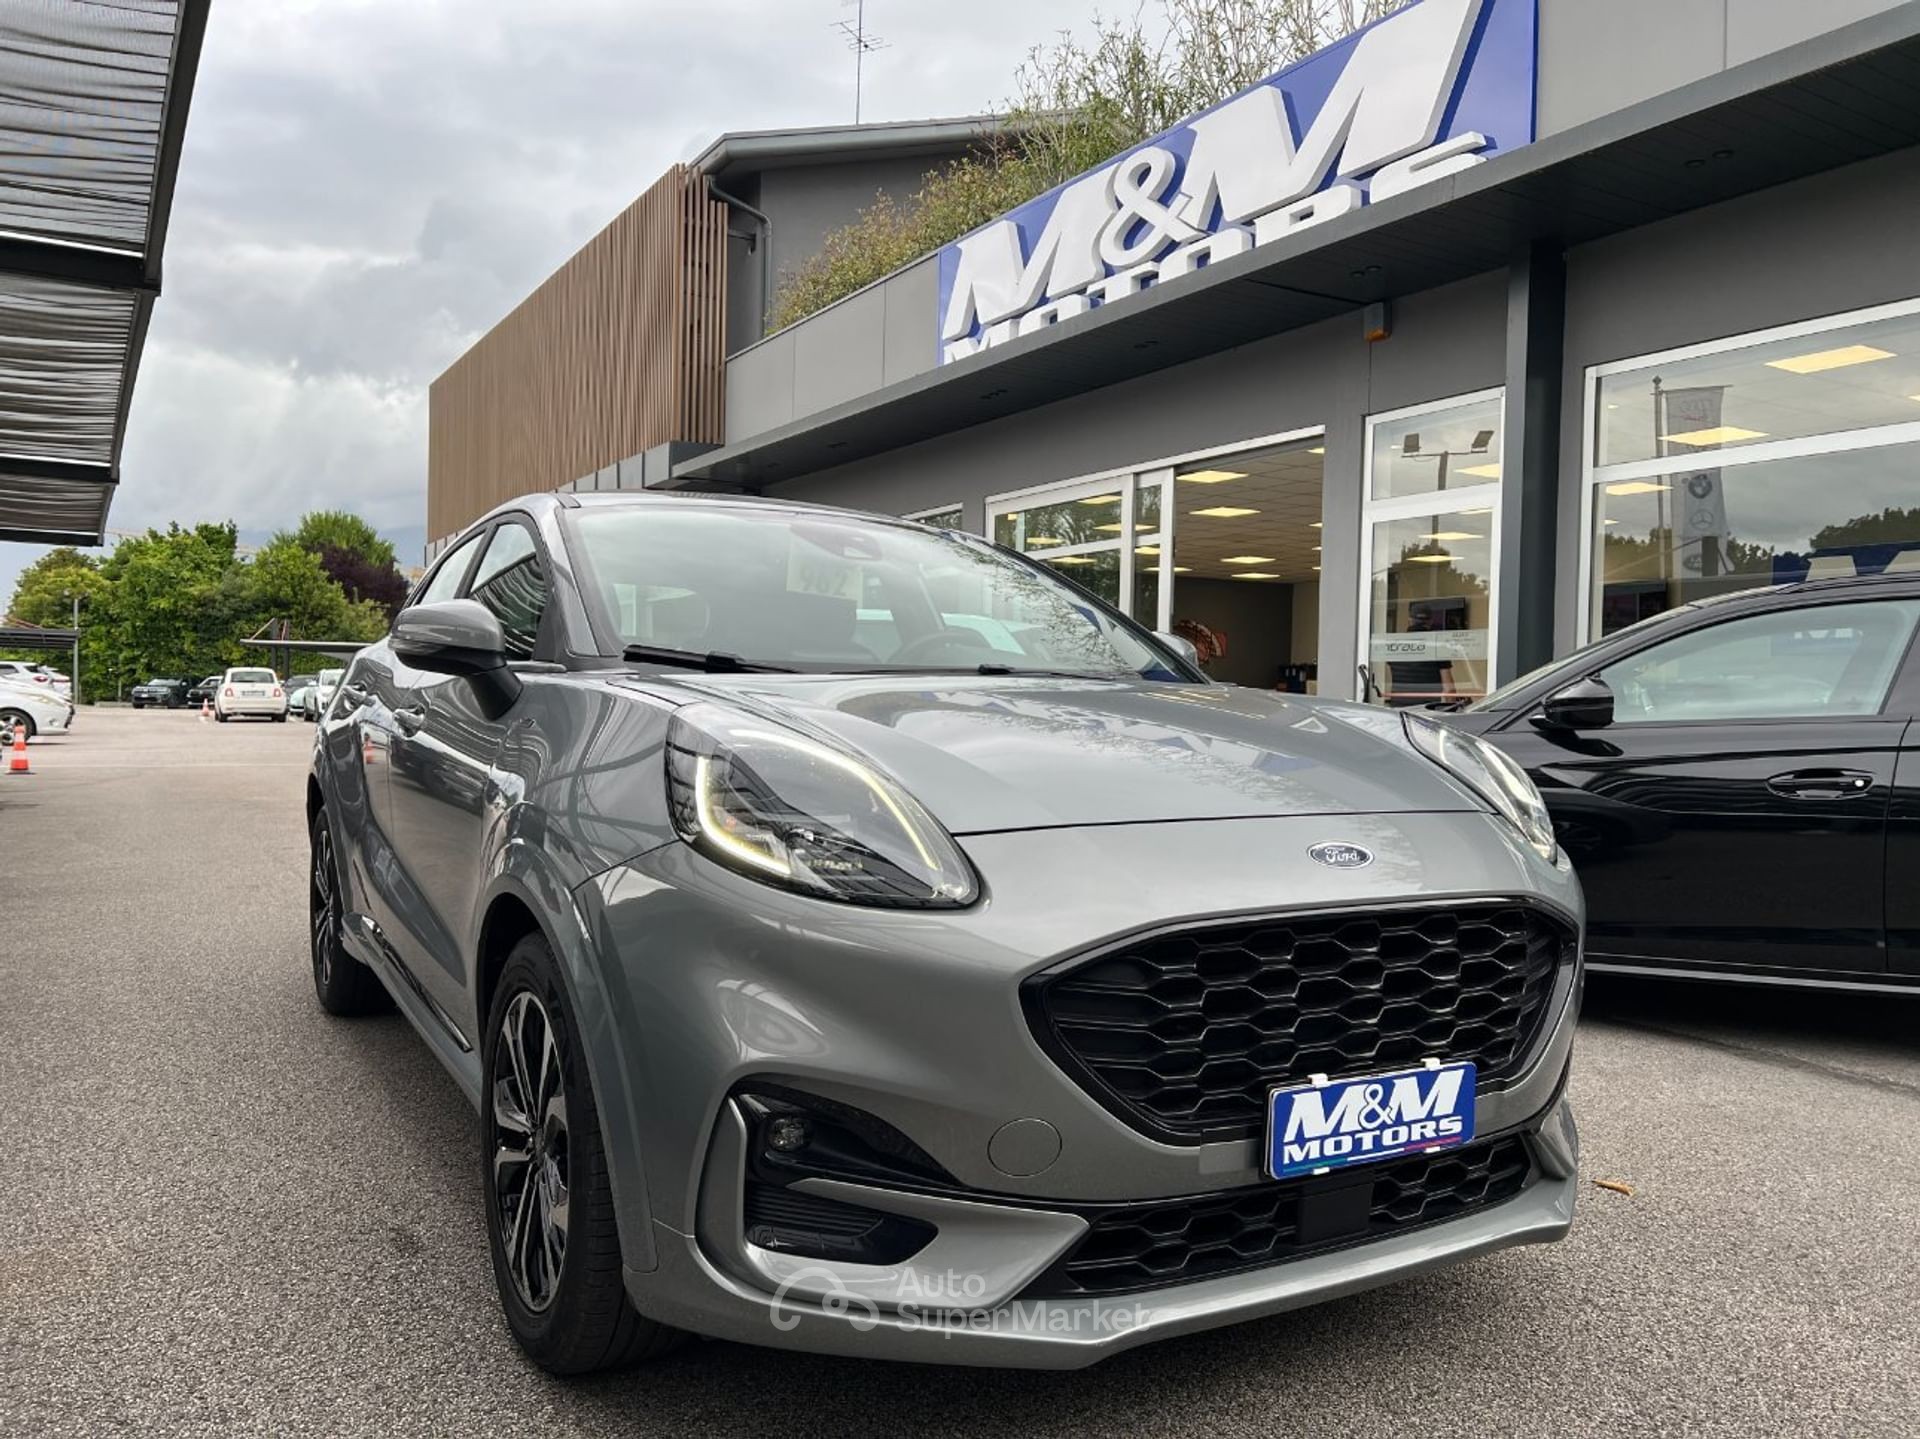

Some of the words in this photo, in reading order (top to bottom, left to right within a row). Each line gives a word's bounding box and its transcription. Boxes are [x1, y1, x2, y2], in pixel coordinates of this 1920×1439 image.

[942, 0, 1483, 341] M&M
[1325, 846, 1360, 863] Ford
[1283, 1068, 1465, 1143] M&M
[1283, 1115, 1463, 1165] MOTORS
